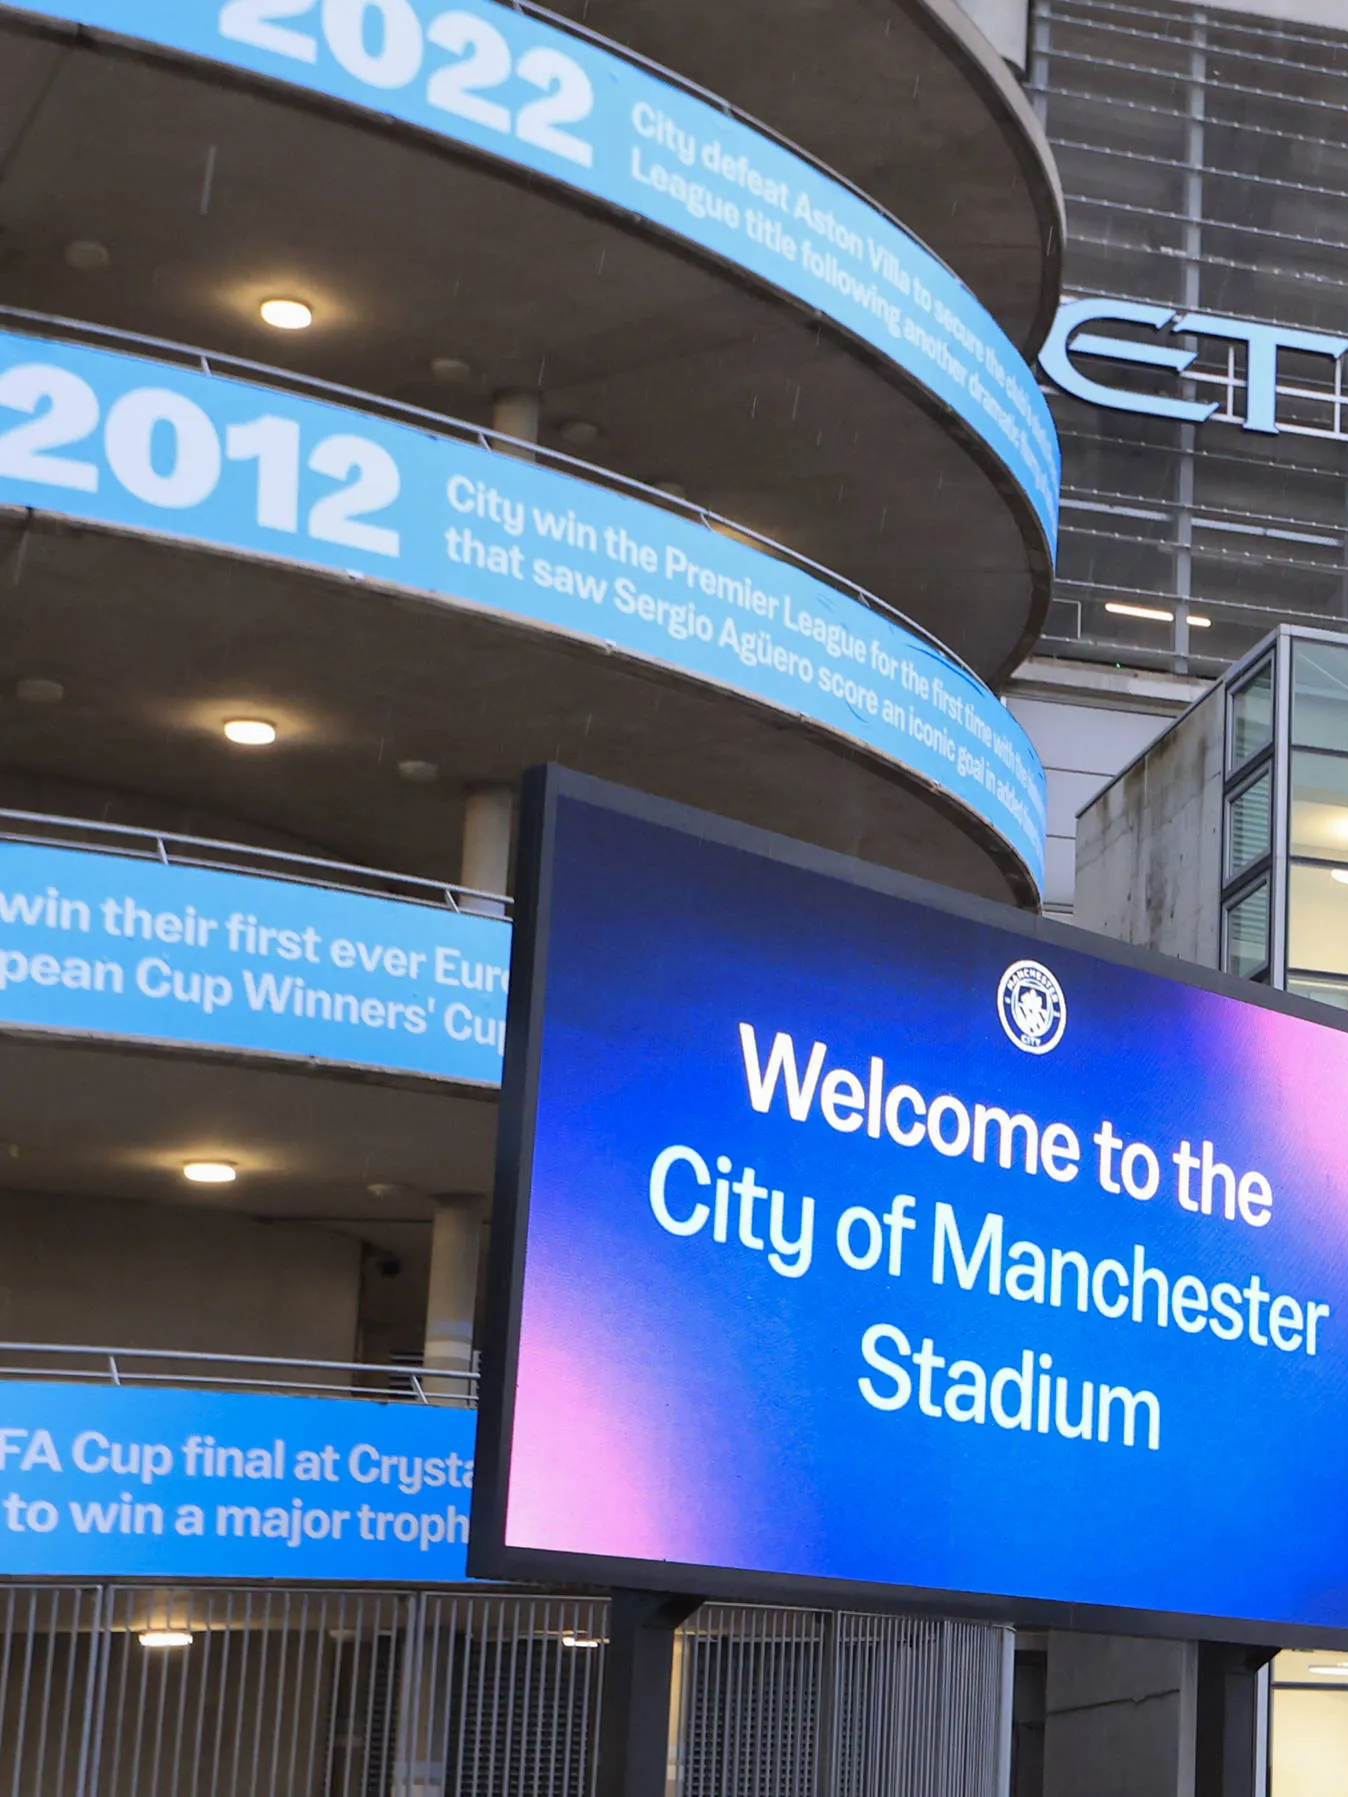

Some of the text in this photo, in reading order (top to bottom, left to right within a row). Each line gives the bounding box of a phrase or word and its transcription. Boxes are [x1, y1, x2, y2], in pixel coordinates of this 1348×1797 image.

[633, 102, 695, 163] City
[703, 139, 787, 207] defeat
[796, 191, 862, 256] Aston
[868, 238, 910, 294] Villa
[913, 277, 930, 310] to
[633, 147, 740, 226] League
[745, 209, 796, 260] title
[801, 238, 901, 337] following
[905, 314, 968, 386] another
[0, 363, 401, 557] 2012
[445, 527, 525, 581] that
[532, 556, 608, 604] saw
[613, 576, 713, 643] Sergio
[718, 616, 814, 683] Agüero
[818, 664, 878, 717] score
[882, 698, 906, 731] an
[909, 707, 956, 763] iconic
[956, 745, 985, 786] goal
[985, 761, 996, 793] in
[446, 475, 525, 538] City
[533, 504, 597, 554] win
[604, 521, 658, 575] the
[665, 545, 779, 620] Premier
[783, 595, 867, 663] League
[872, 641, 900, 679] for
[901, 659, 929, 701] the
[932, 678, 963, 726] first
[966, 703, 992, 747] time
[0, 885, 91, 933] win
[101, 896, 219, 948] their
[225, 913, 322, 963] first
[330, 937, 428, 980] ever
[0, 948, 124, 995] pean
[136, 956, 233, 1014] Cup
[242, 969, 436, 1034] Winners'
[1006, 968, 1059, 1003] MANCHESTER
[738, 1022, 1273, 1227] Welcome to the
[648, 1144, 1330, 1356] City of Manchester
[0, 1427, 63, 1472] FA
[72, 1431, 173, 1484] Cup
[180, 1436, 285, 1481] final
[294, 1445, 341, 1484] at
[857, 1323, 1160, 1450] Stadium
[3, 1491, 60, 1533] to
[69, 1492, 164, 1535] win
[174, 1505, 200, 1536] a
[216, 1499, 351, 1548] major
